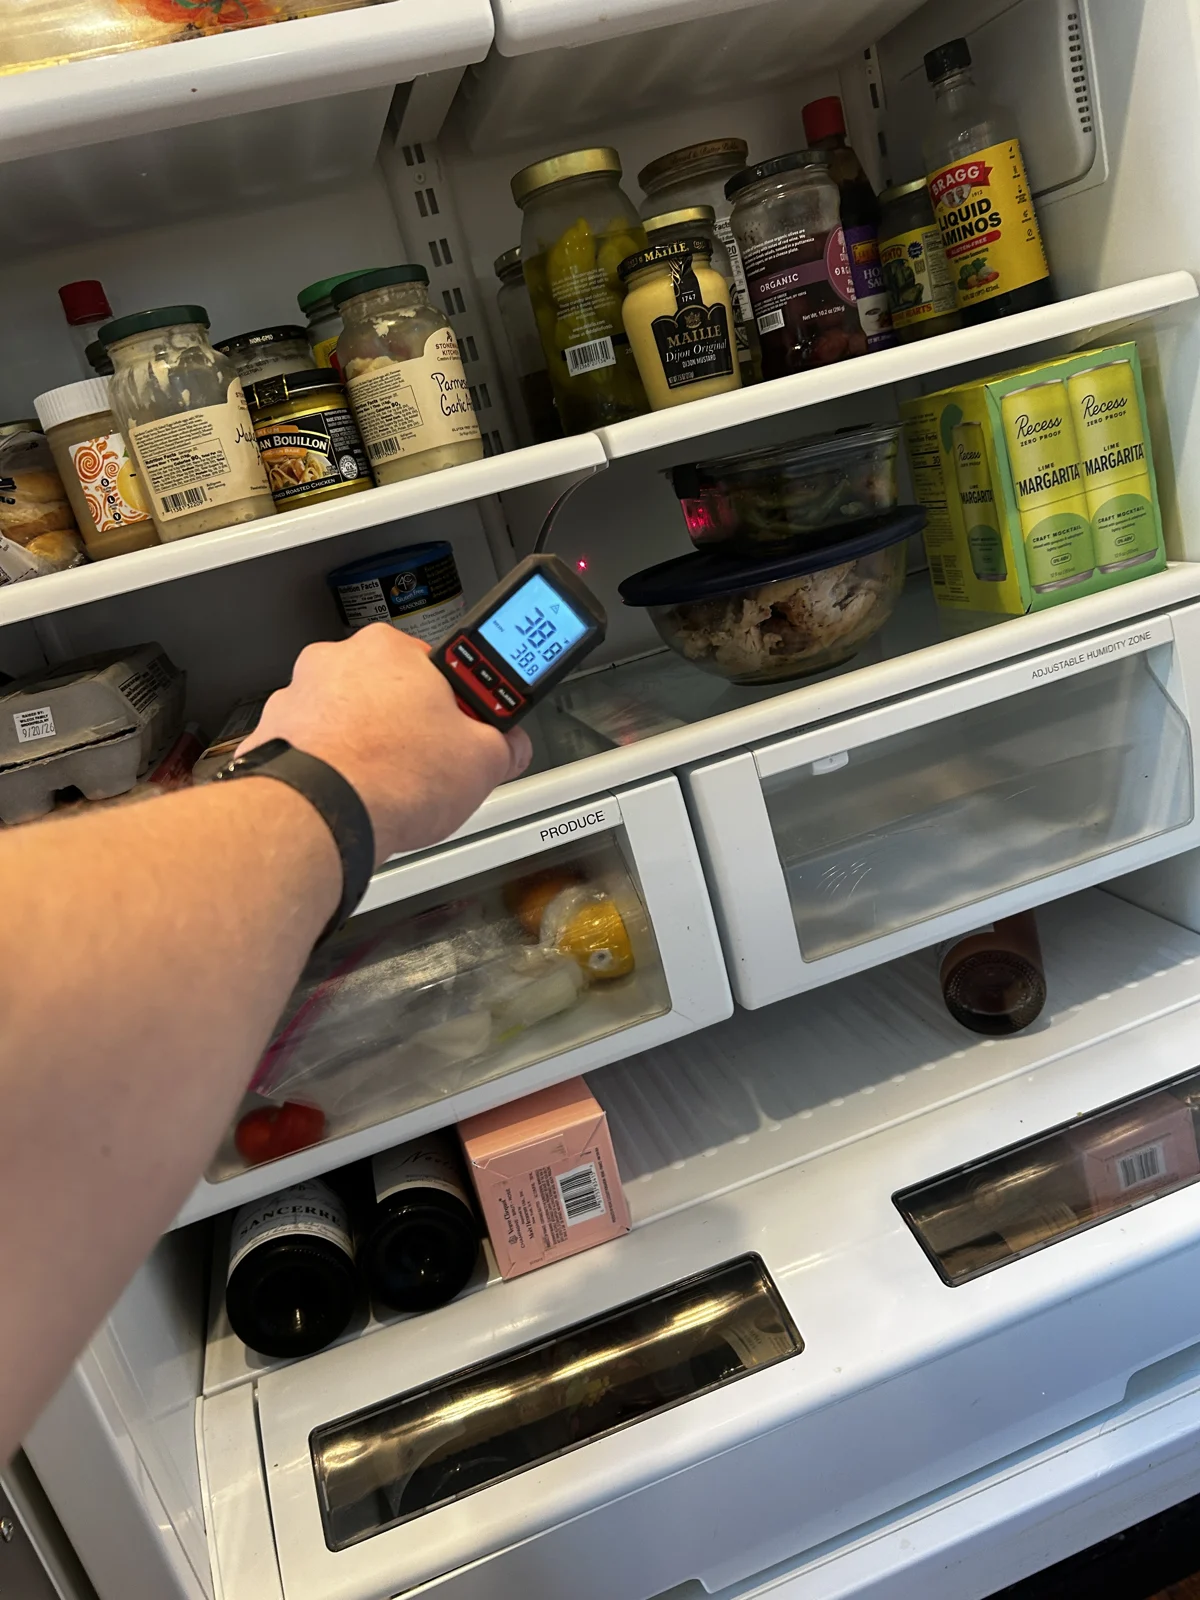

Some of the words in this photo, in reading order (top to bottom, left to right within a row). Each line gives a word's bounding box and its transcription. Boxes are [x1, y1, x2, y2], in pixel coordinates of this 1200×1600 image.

[932, 166, 980, 196] BRAGG
[938, 198, 992, 231] LIQUID
[644, 242, 688, 262] MAILLE
[760, 274, 799, 292] ORGANIC
[682, 294, 696, 302] 1747
[801, 313, 810, 321] Net
[818, 308, 827, 316] 10.2
[249, 334, 274, 344] NON-GMO
[666, 324, 722, 349] MAILLE
[666, 350, 691, 363] Dijon
[693, 339, 727, 354] Original
[682, 358, 698, 368] DIJON
[696, 353, 716, 365] MUSTARD
[440, 394, 466, 416] Garlic
[1081, 394, 1128, 419] Recess
[1014, 414, 1062, 440] Recess
[1086, 418, 1103, 427] ZERO
[1105, 410, 1127, 420] PROOF
[274, 436, 327, 451] BOUILLON
[1020, 437, 1037, 447] ZERO
[1040, 430, 1062, 440] PROOF
[1103, 442, 1120, 452] LIME
[958, 443, 982, 462] Recess
[1038, 462, 1055, 472] LIME
[285, 484, 310, 495] ROASTED
[310, 477, 335, 488] CHICKEN
[1097, 514, 1115, 523] CRAFT
[1115, 505, 1145, 518] MOCKTAIL
[1031, 533, 1050, 543] CRAFT
[1051, 524, 1082, 537] MOCKTAIL
[360, 580, 379, 590] Facts
[413, 588, 424, 597] Free
[374, 604, 386, 613] 100
[399, 599, 427, 612] SEASONED
[515, 607, 562, 662] 38.8
[458, 645, 474, 662] MODE
[1032, 654, 1086, 679] ADJUSTABLE
[1086, 639, 1127, 660] HUMIDITY
[1128, 631, 1152, 646] ZONE
[480, 670, 492, 682] SET
[498, 688, 516, 706] ALARM
[540, 810, 606, 842] PRODUCE
[241, 1204, 342, 1236] SANCERRE
